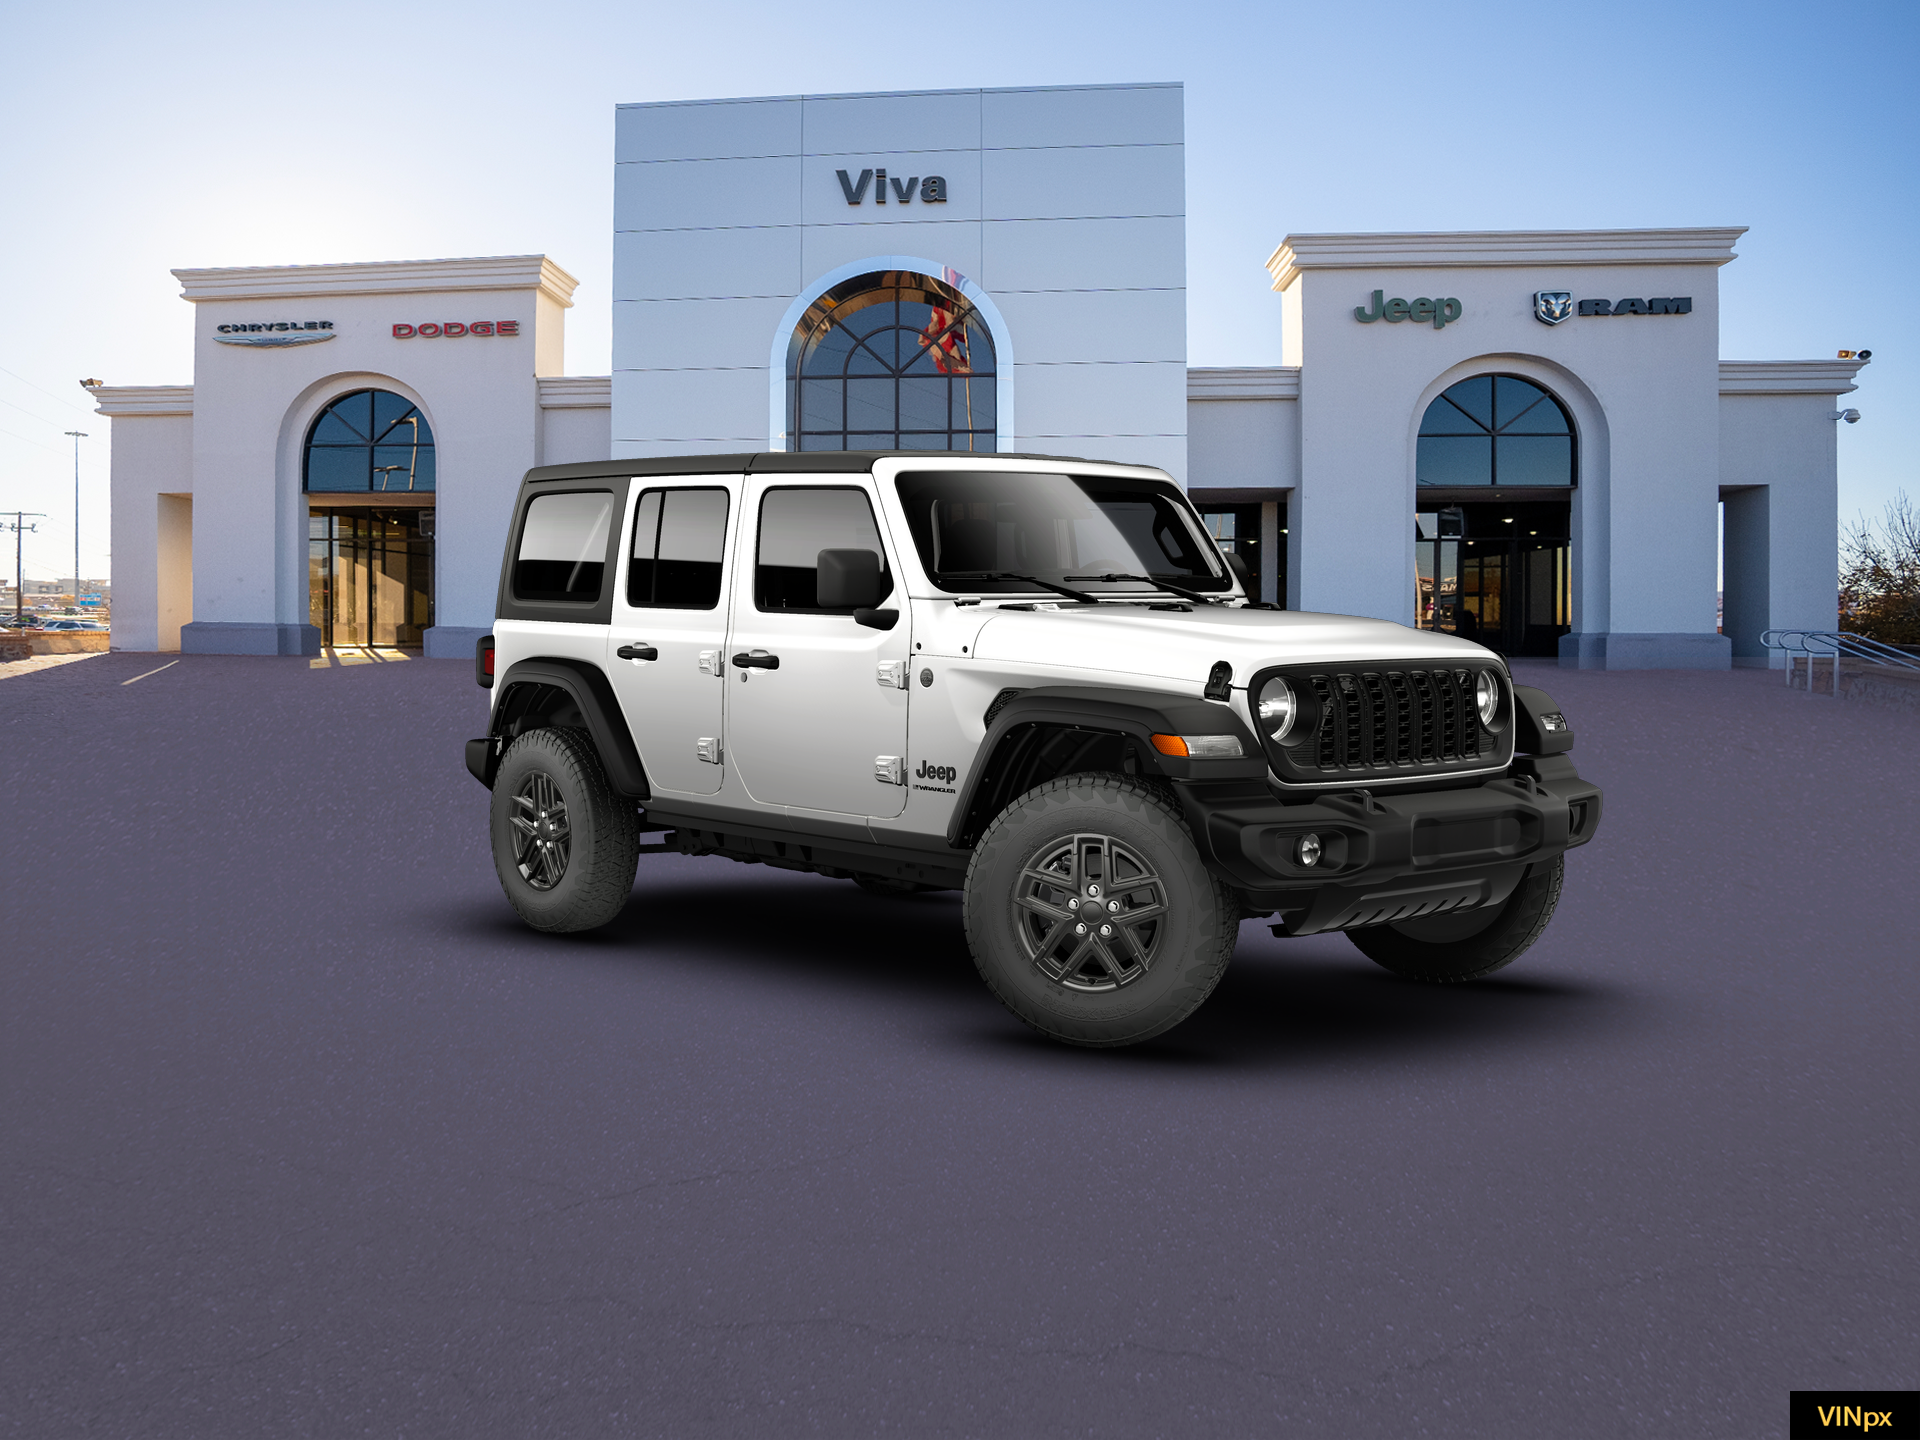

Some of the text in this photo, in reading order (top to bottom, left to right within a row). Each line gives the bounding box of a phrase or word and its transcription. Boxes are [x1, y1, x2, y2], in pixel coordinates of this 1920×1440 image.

[835, 168, 947, 205] Viva
[1354, 289, 1462, 330] Jeep
[1578, 297, 1692, 316] RAM
[217, 320, 334, 333] CHRYSLER
[392, 319, 519, 338] DODGE
[916, 760, 956, 784] Jeep
[918, 784, 956, 795] WRANGLER
